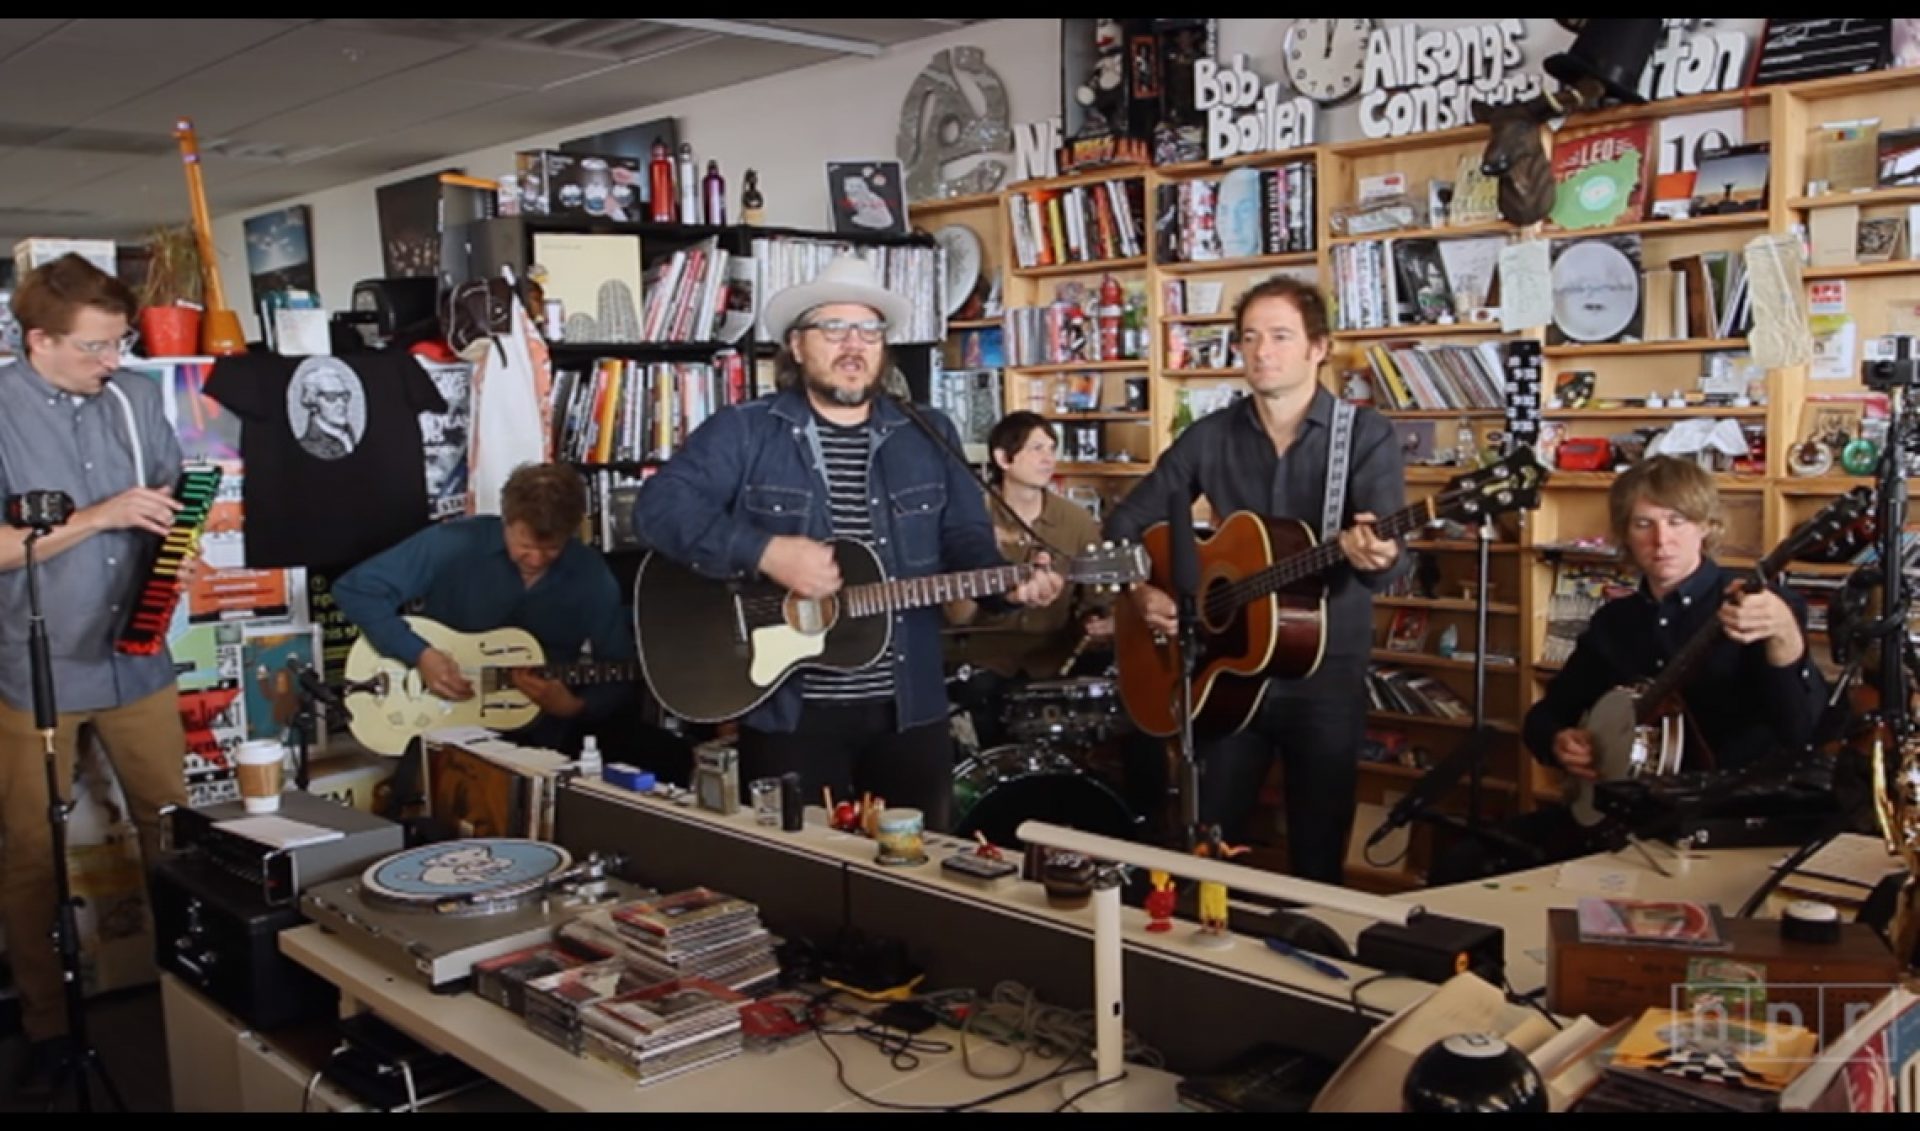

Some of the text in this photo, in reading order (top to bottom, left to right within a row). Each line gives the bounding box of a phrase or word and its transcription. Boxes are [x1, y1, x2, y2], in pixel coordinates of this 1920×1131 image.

[1194, 53, 1258, 111] Bob
[1361, 19, 1521, 93] Allsongs
[1208, 81, 1314, 160] Boilen
